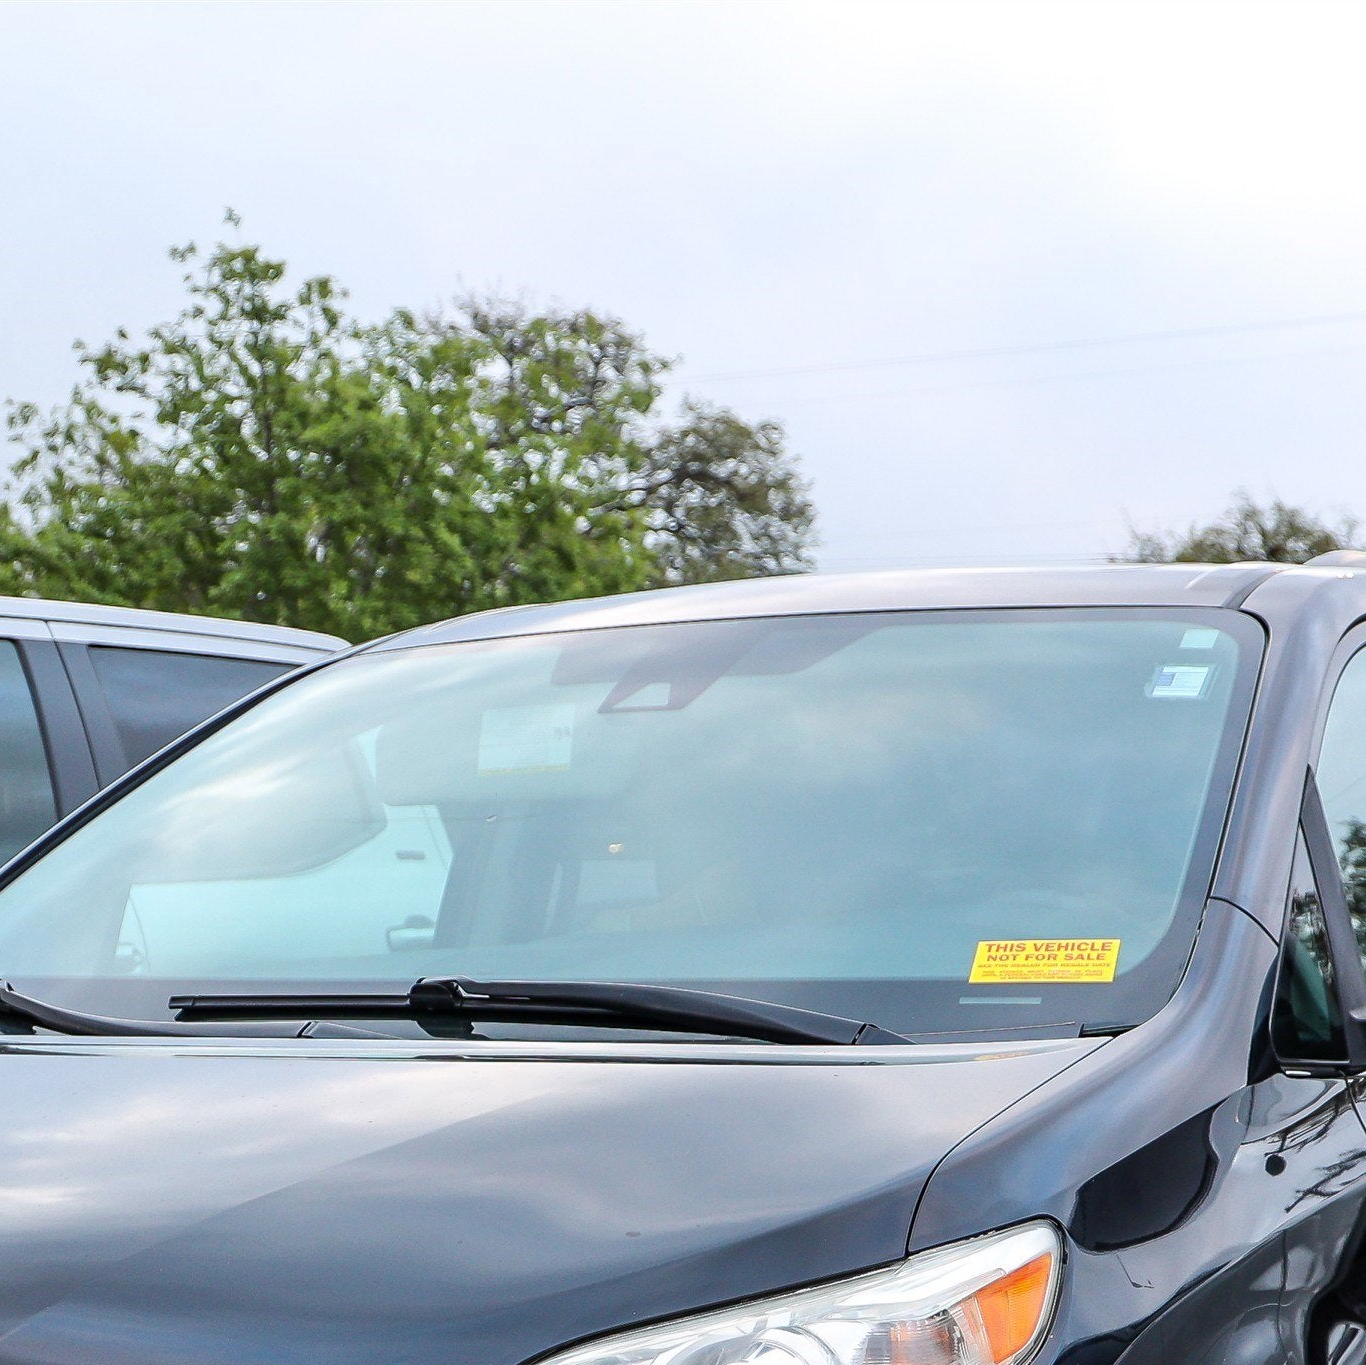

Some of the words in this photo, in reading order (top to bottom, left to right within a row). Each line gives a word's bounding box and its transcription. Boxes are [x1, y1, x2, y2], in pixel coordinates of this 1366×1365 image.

[985, 943, 1027, 953] THIS
[1034, 942, 1113, 952] VEHICLE
[987, 954, 1020, 962] NOT
[1025, 953, 1058, 961] FOR
[1064, 953, 1107, 961] SALE
